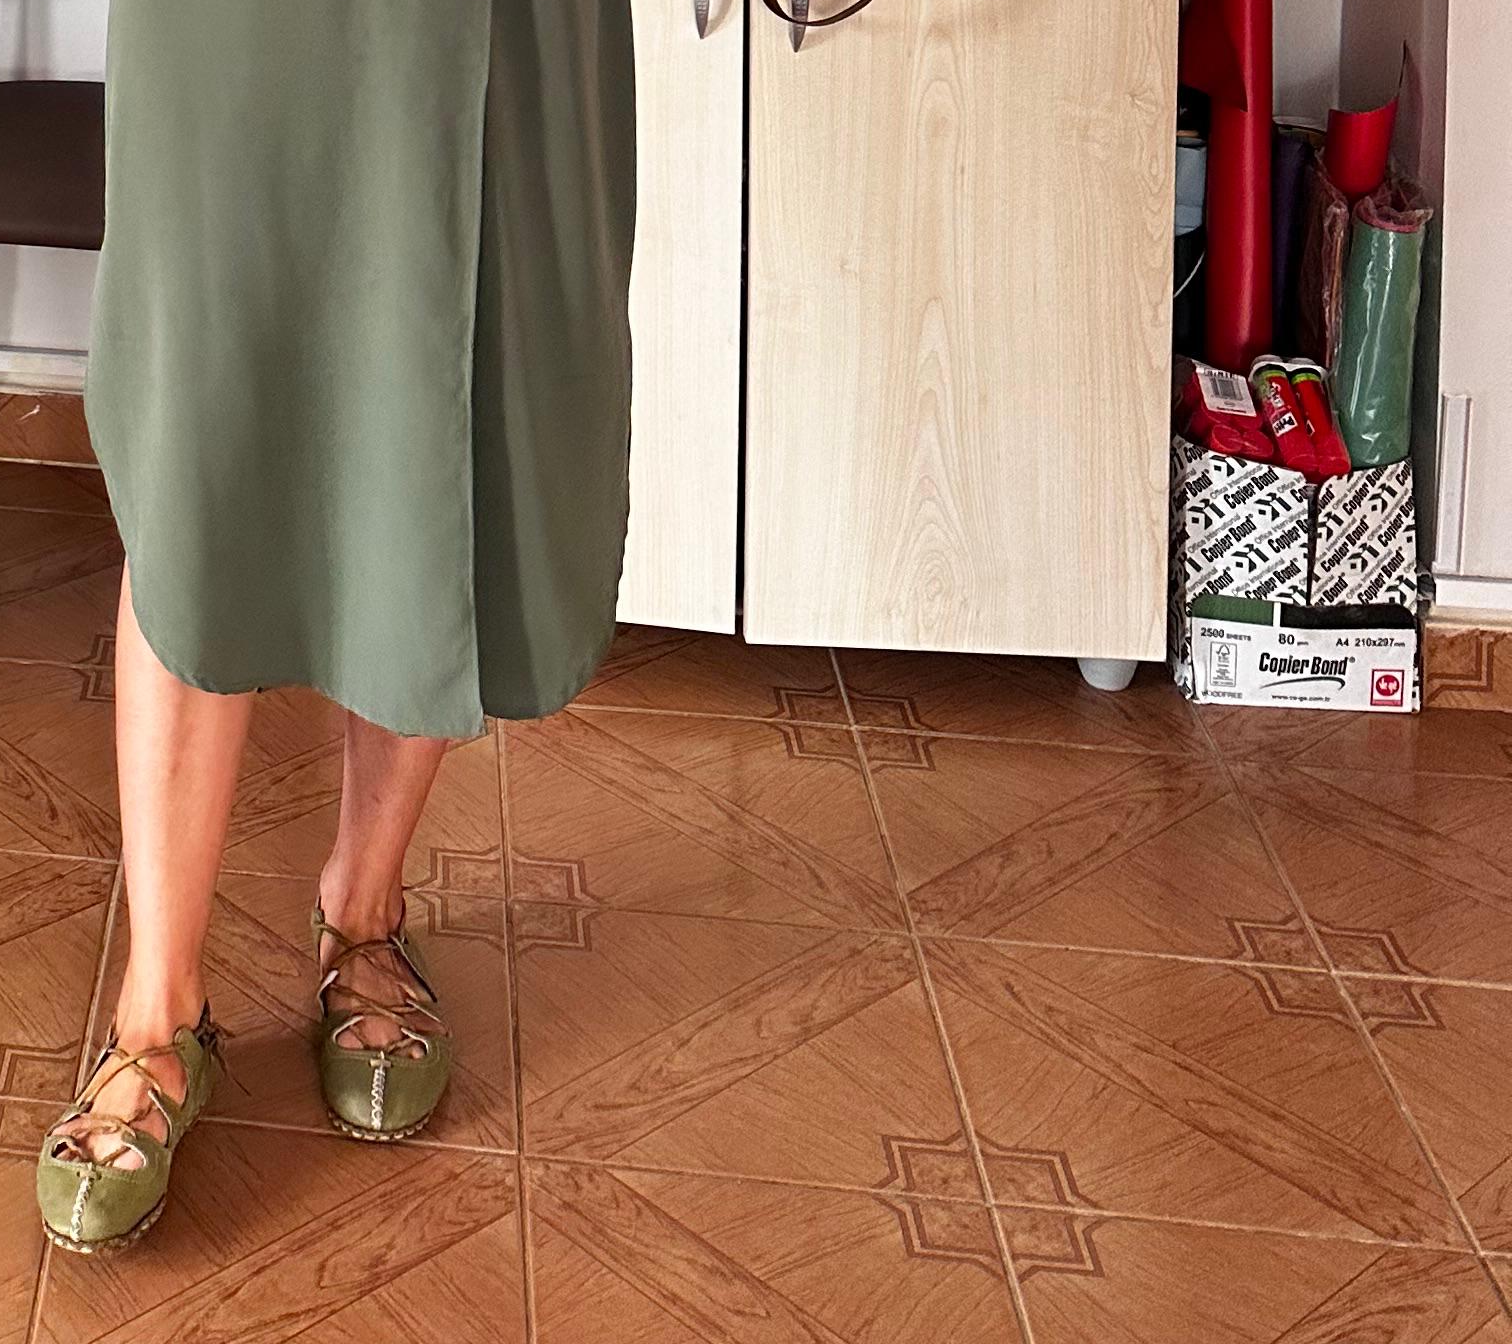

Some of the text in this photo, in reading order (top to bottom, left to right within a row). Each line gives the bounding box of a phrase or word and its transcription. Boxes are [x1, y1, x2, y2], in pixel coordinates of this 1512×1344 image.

[1223, 465, 1280, 509] Copier Bond
[1342, 482, 1370, 516] Copier
[1201, 516, 1257, 563] Copier Bond
[1268, 525, 1301, 553] Copier
[1320, 541, 1349, 572] Copier
[1345, 518, 1370, 547] Bond
[1377, 513, 1405, 547] Copier
[1206, 568, 1234, 595] Bond
[1244, 578, 1278, 601] Copier
[1272, 559, 1302, 584] Bond
[1322, 575, 1349, 603] Bond
[1356, 550, 1405, 604] Copier Bond
[1200, 627, 1225, 638] 2500
[1278, 633, 1295, 645] 80
[1335, 638, 1350, 647] A4
[1258, 652, 1310, 677] Copier
